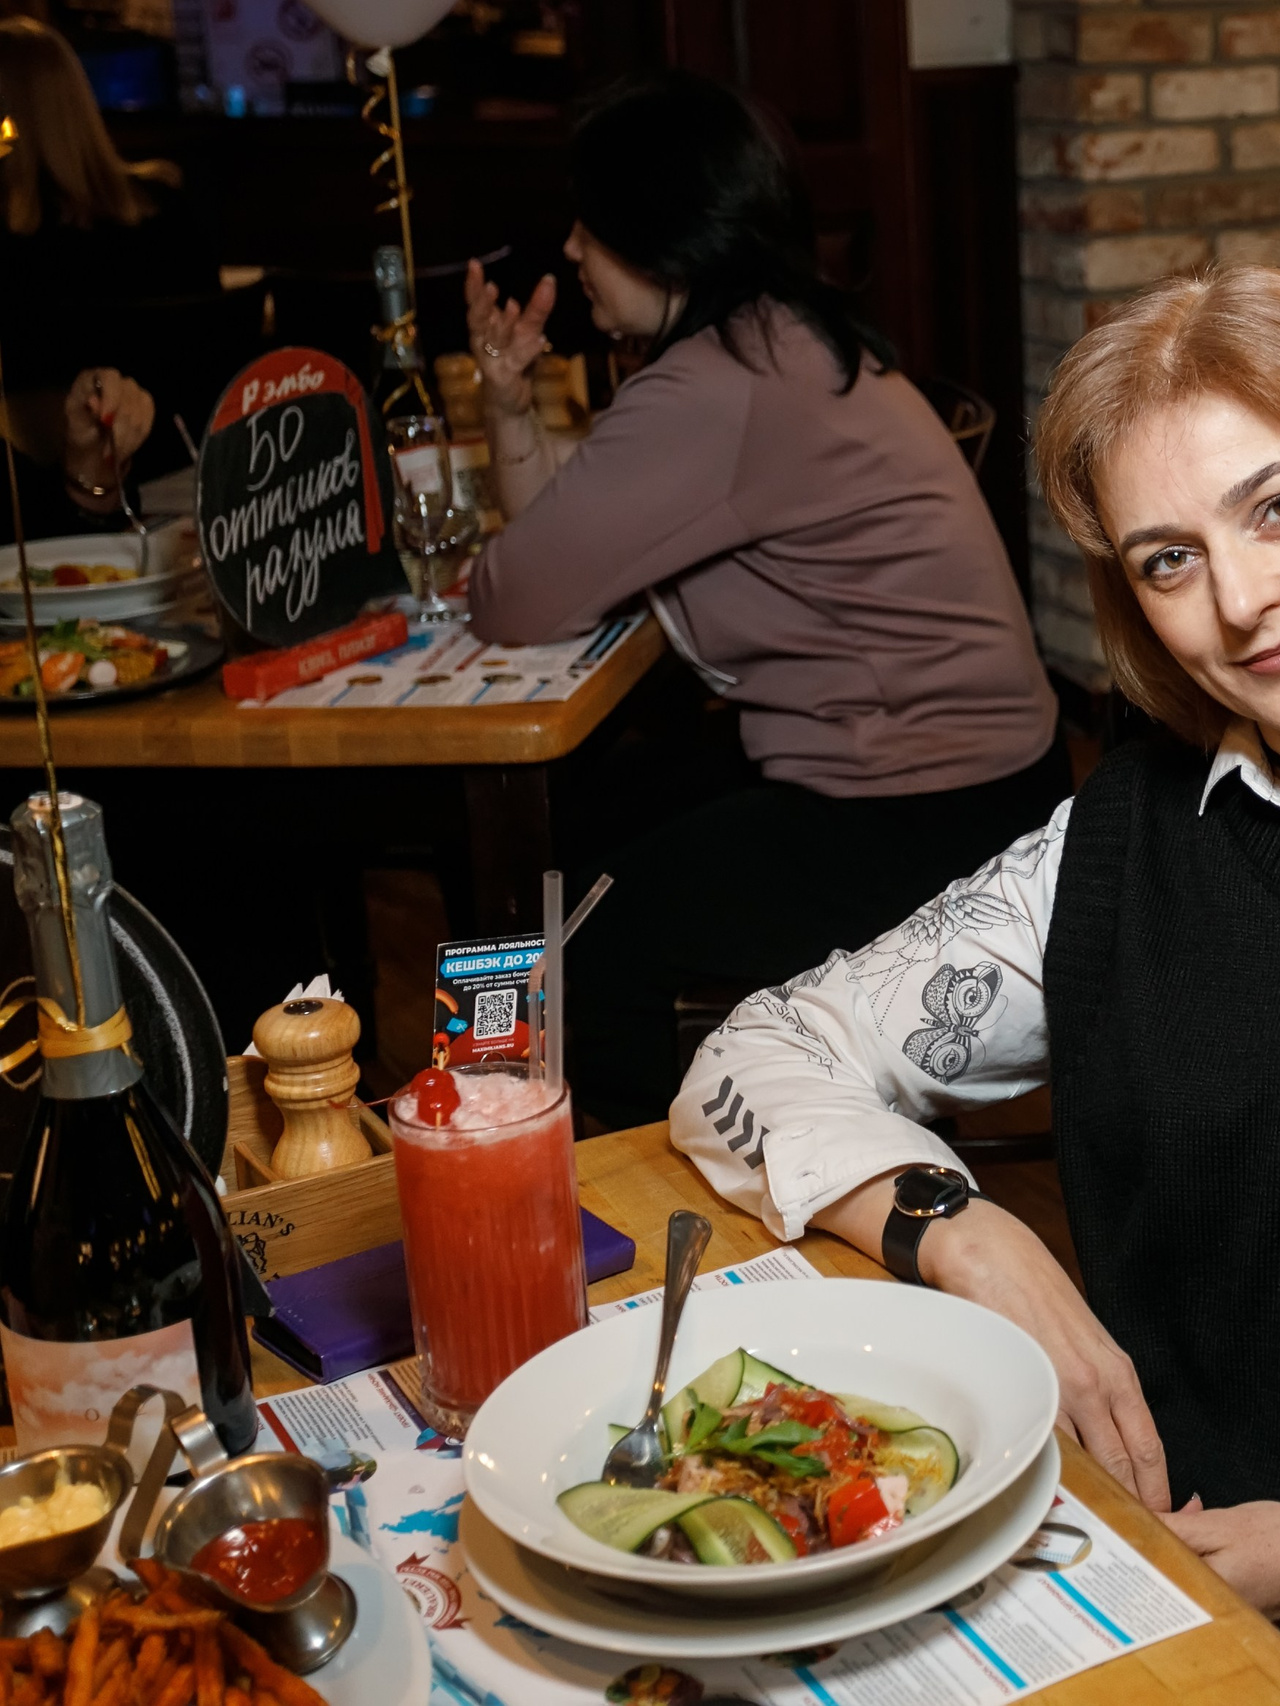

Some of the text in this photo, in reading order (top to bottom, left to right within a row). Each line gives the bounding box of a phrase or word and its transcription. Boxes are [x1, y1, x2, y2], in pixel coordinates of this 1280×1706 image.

[246, 404, 304, 491] 50
[445, 939, 547, 957] ПРОГРАММА ЛОЯЛЬНОСТ
[446, 956, 501, 973] КЕШБЭК
[503, 954, 523, 968] ДО
[452, 974, 494, 985] Оплачивайте
[512, 970, 530, 979] бонус
[463, 984, 472, 992] до
[494, 980, 515, 988] суммы
[227, 1210, 296, 1237] LIAN'S
